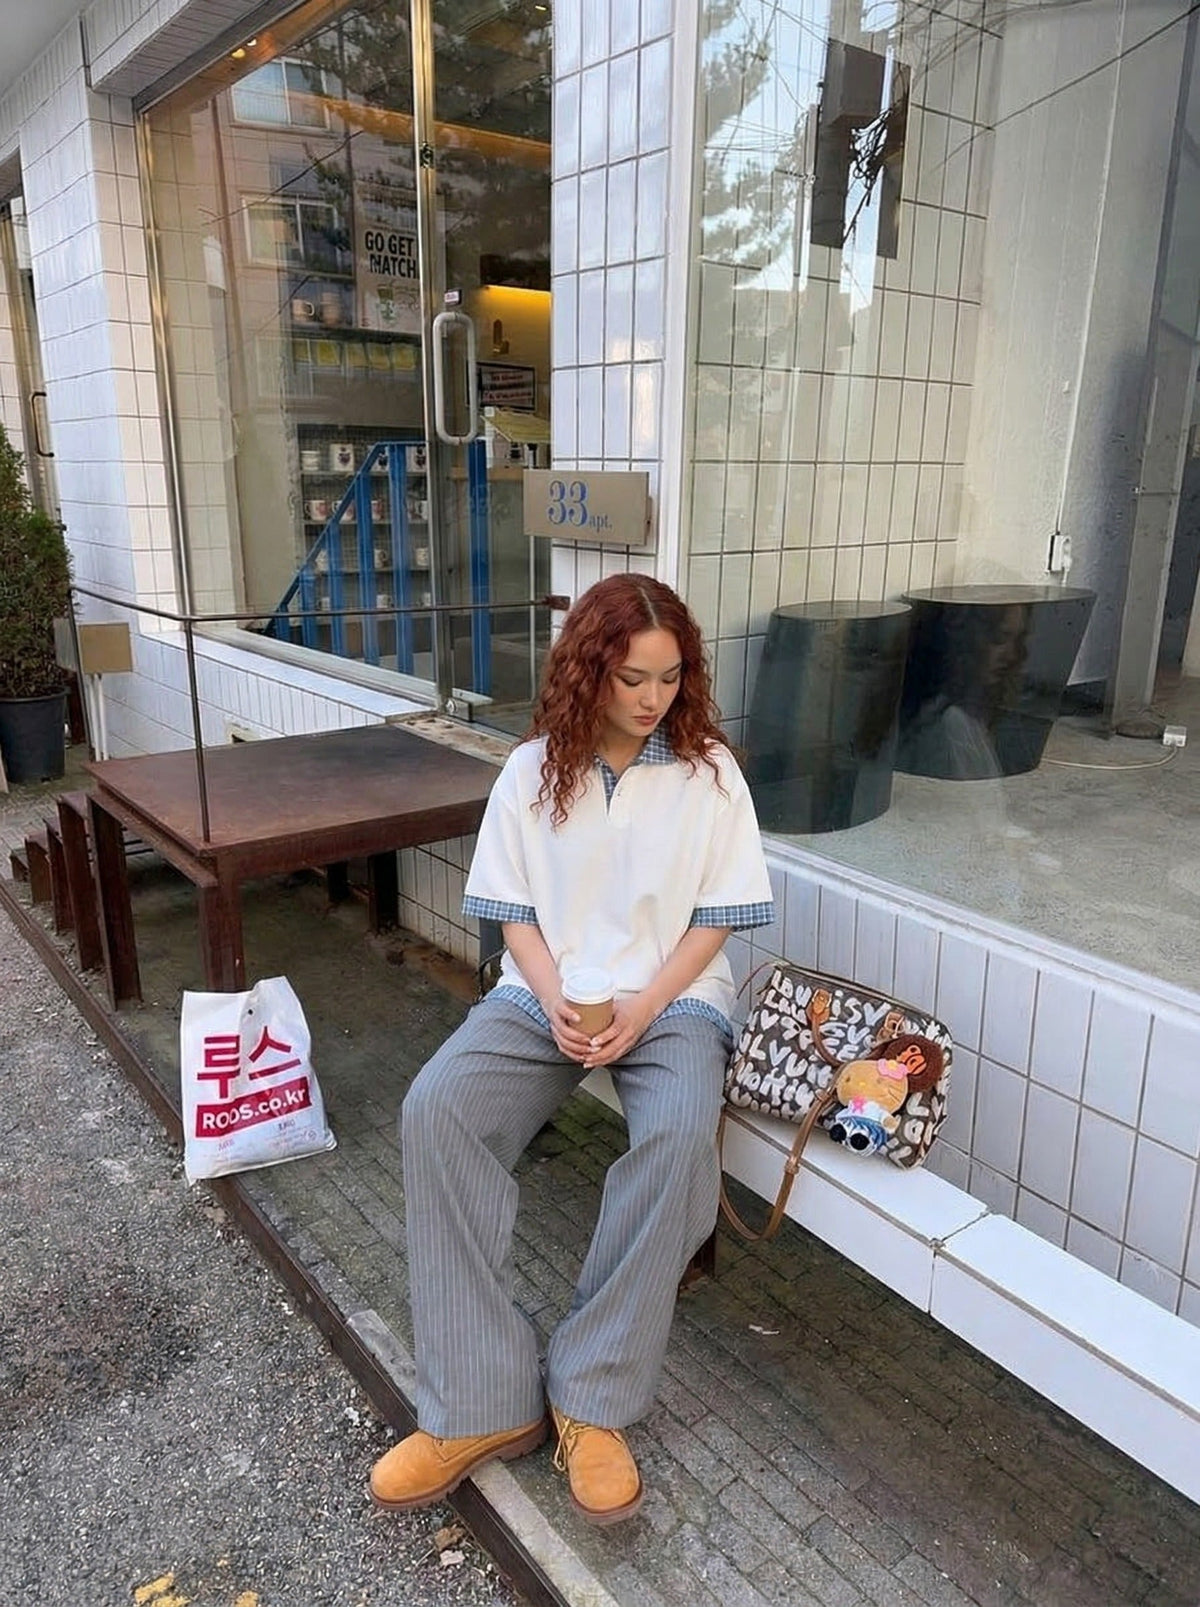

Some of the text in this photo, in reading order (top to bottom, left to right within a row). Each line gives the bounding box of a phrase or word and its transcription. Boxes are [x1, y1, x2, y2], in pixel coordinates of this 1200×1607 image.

[365, 231, 414, 257] GO GET
[197, 1026, 301, 1099] 루스
[202, 1088, 306, 1130] ROOS.co.kr
